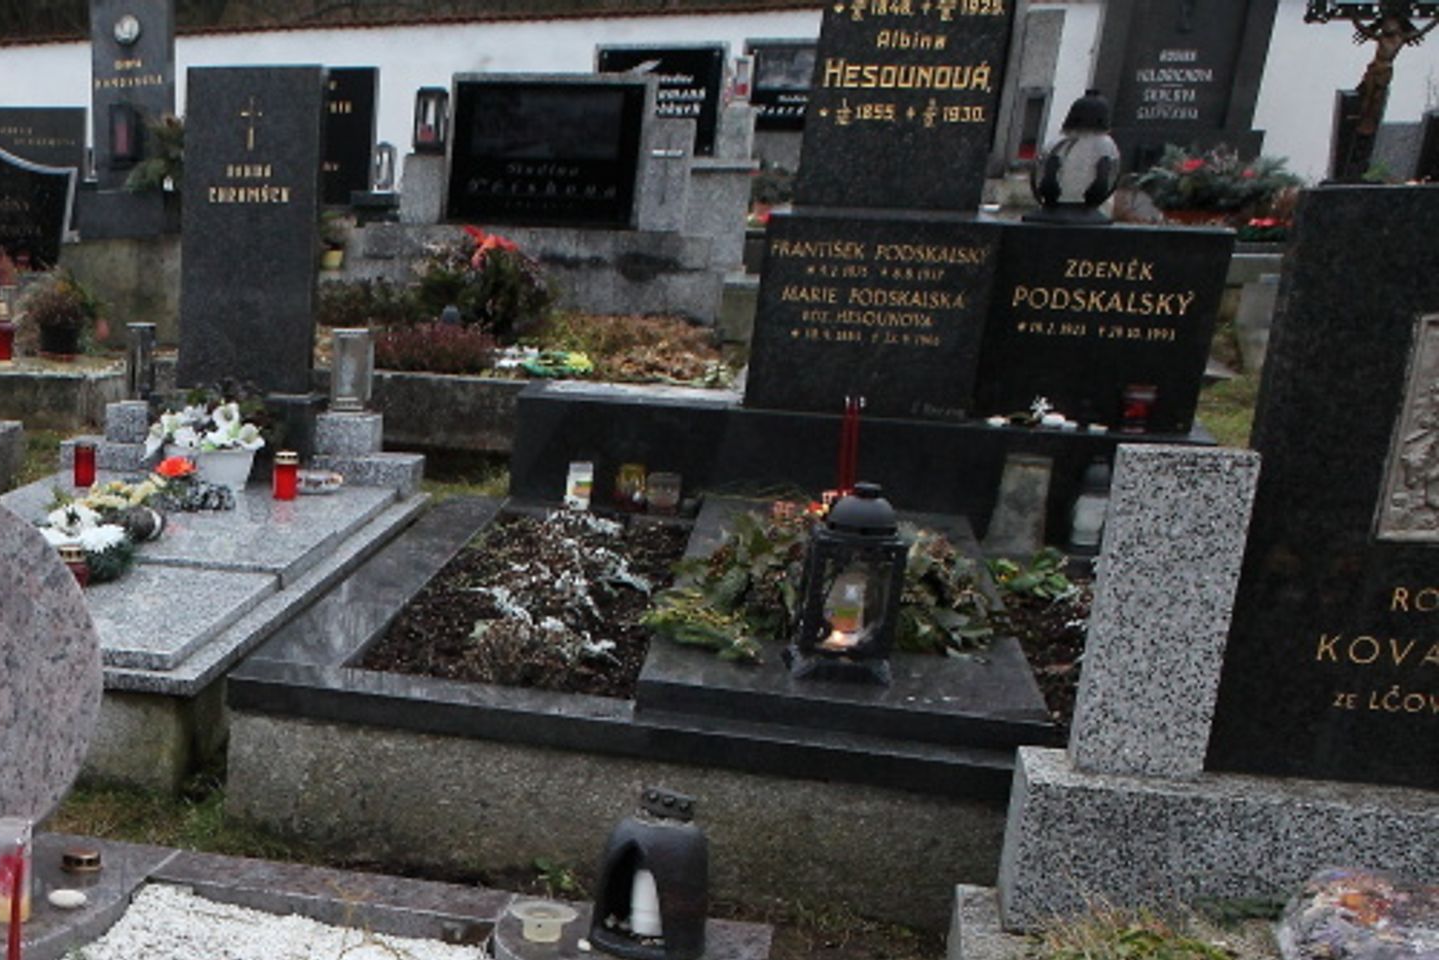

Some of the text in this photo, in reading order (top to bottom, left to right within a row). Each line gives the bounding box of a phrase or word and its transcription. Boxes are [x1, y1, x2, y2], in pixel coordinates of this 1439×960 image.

[876, 29, 948, 49] Albina
[1064, 257, 1155, 281] ZDENĚK
[781, 285, 838, 304] MARIE
[1012, 284, 1195, 316] PODSKALSKÝ
